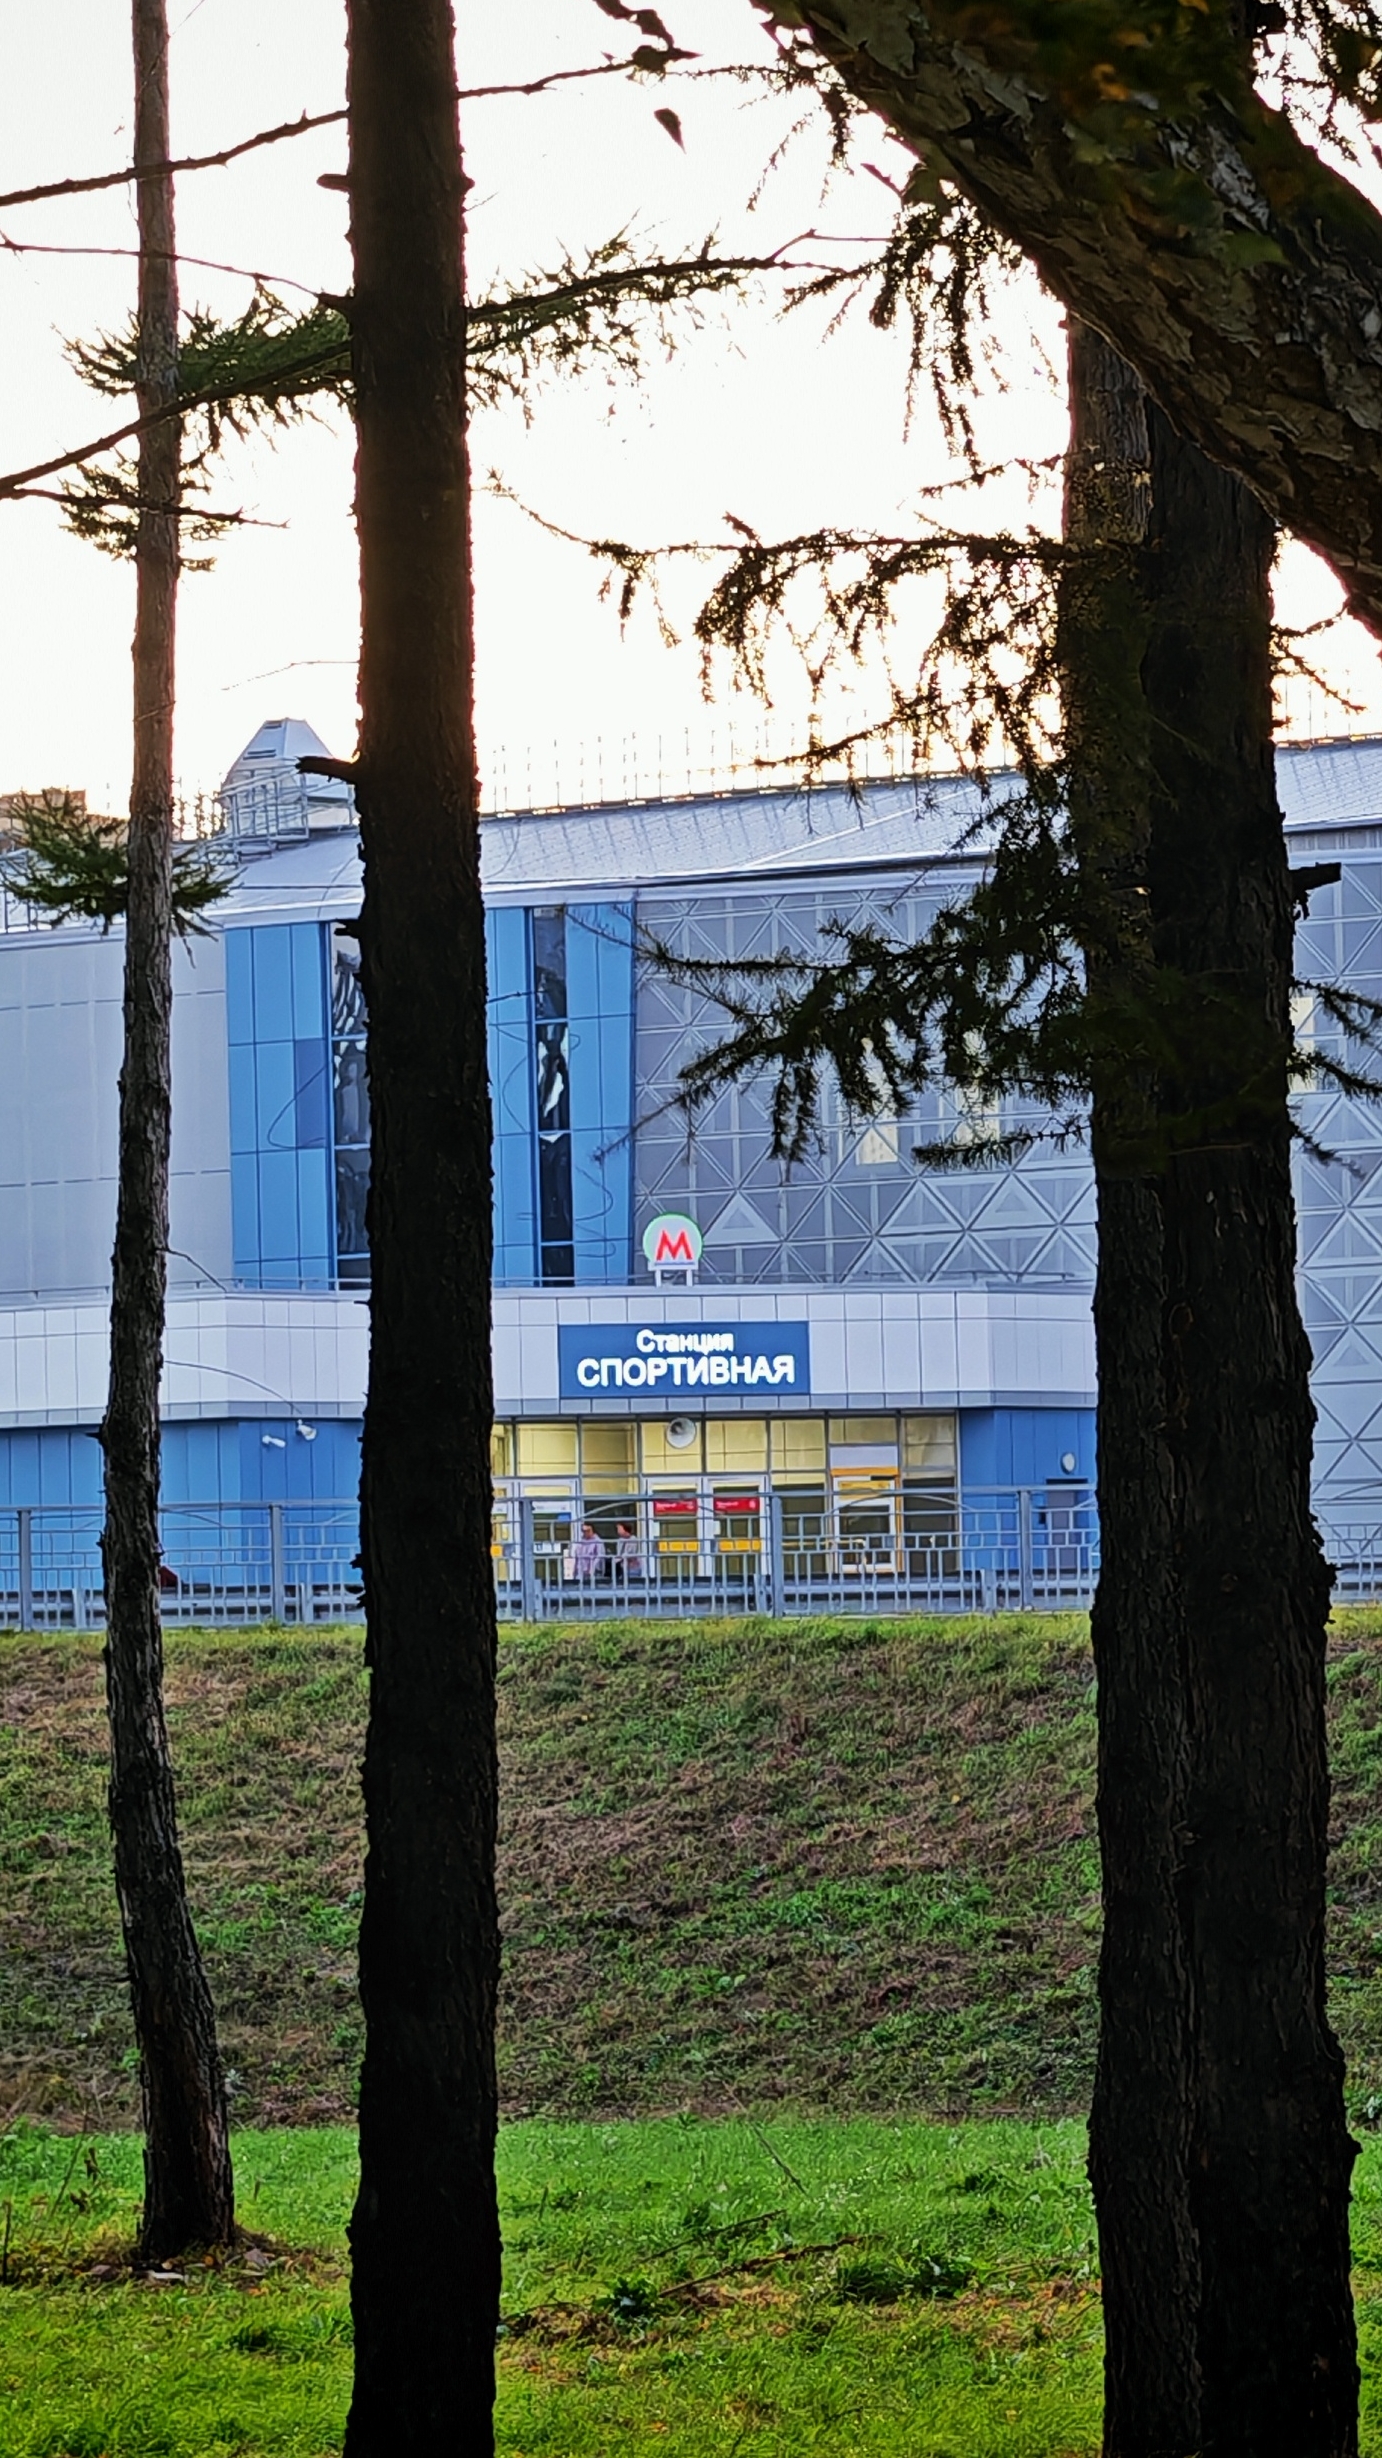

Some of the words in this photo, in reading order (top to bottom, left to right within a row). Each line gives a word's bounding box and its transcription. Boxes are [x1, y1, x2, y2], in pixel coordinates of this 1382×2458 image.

[656, 1229, 693, 1260] М
[636, 1329, 734, 1354] Станция
[577, 1355, 795, 1387] СПОРТИВНАЯ
